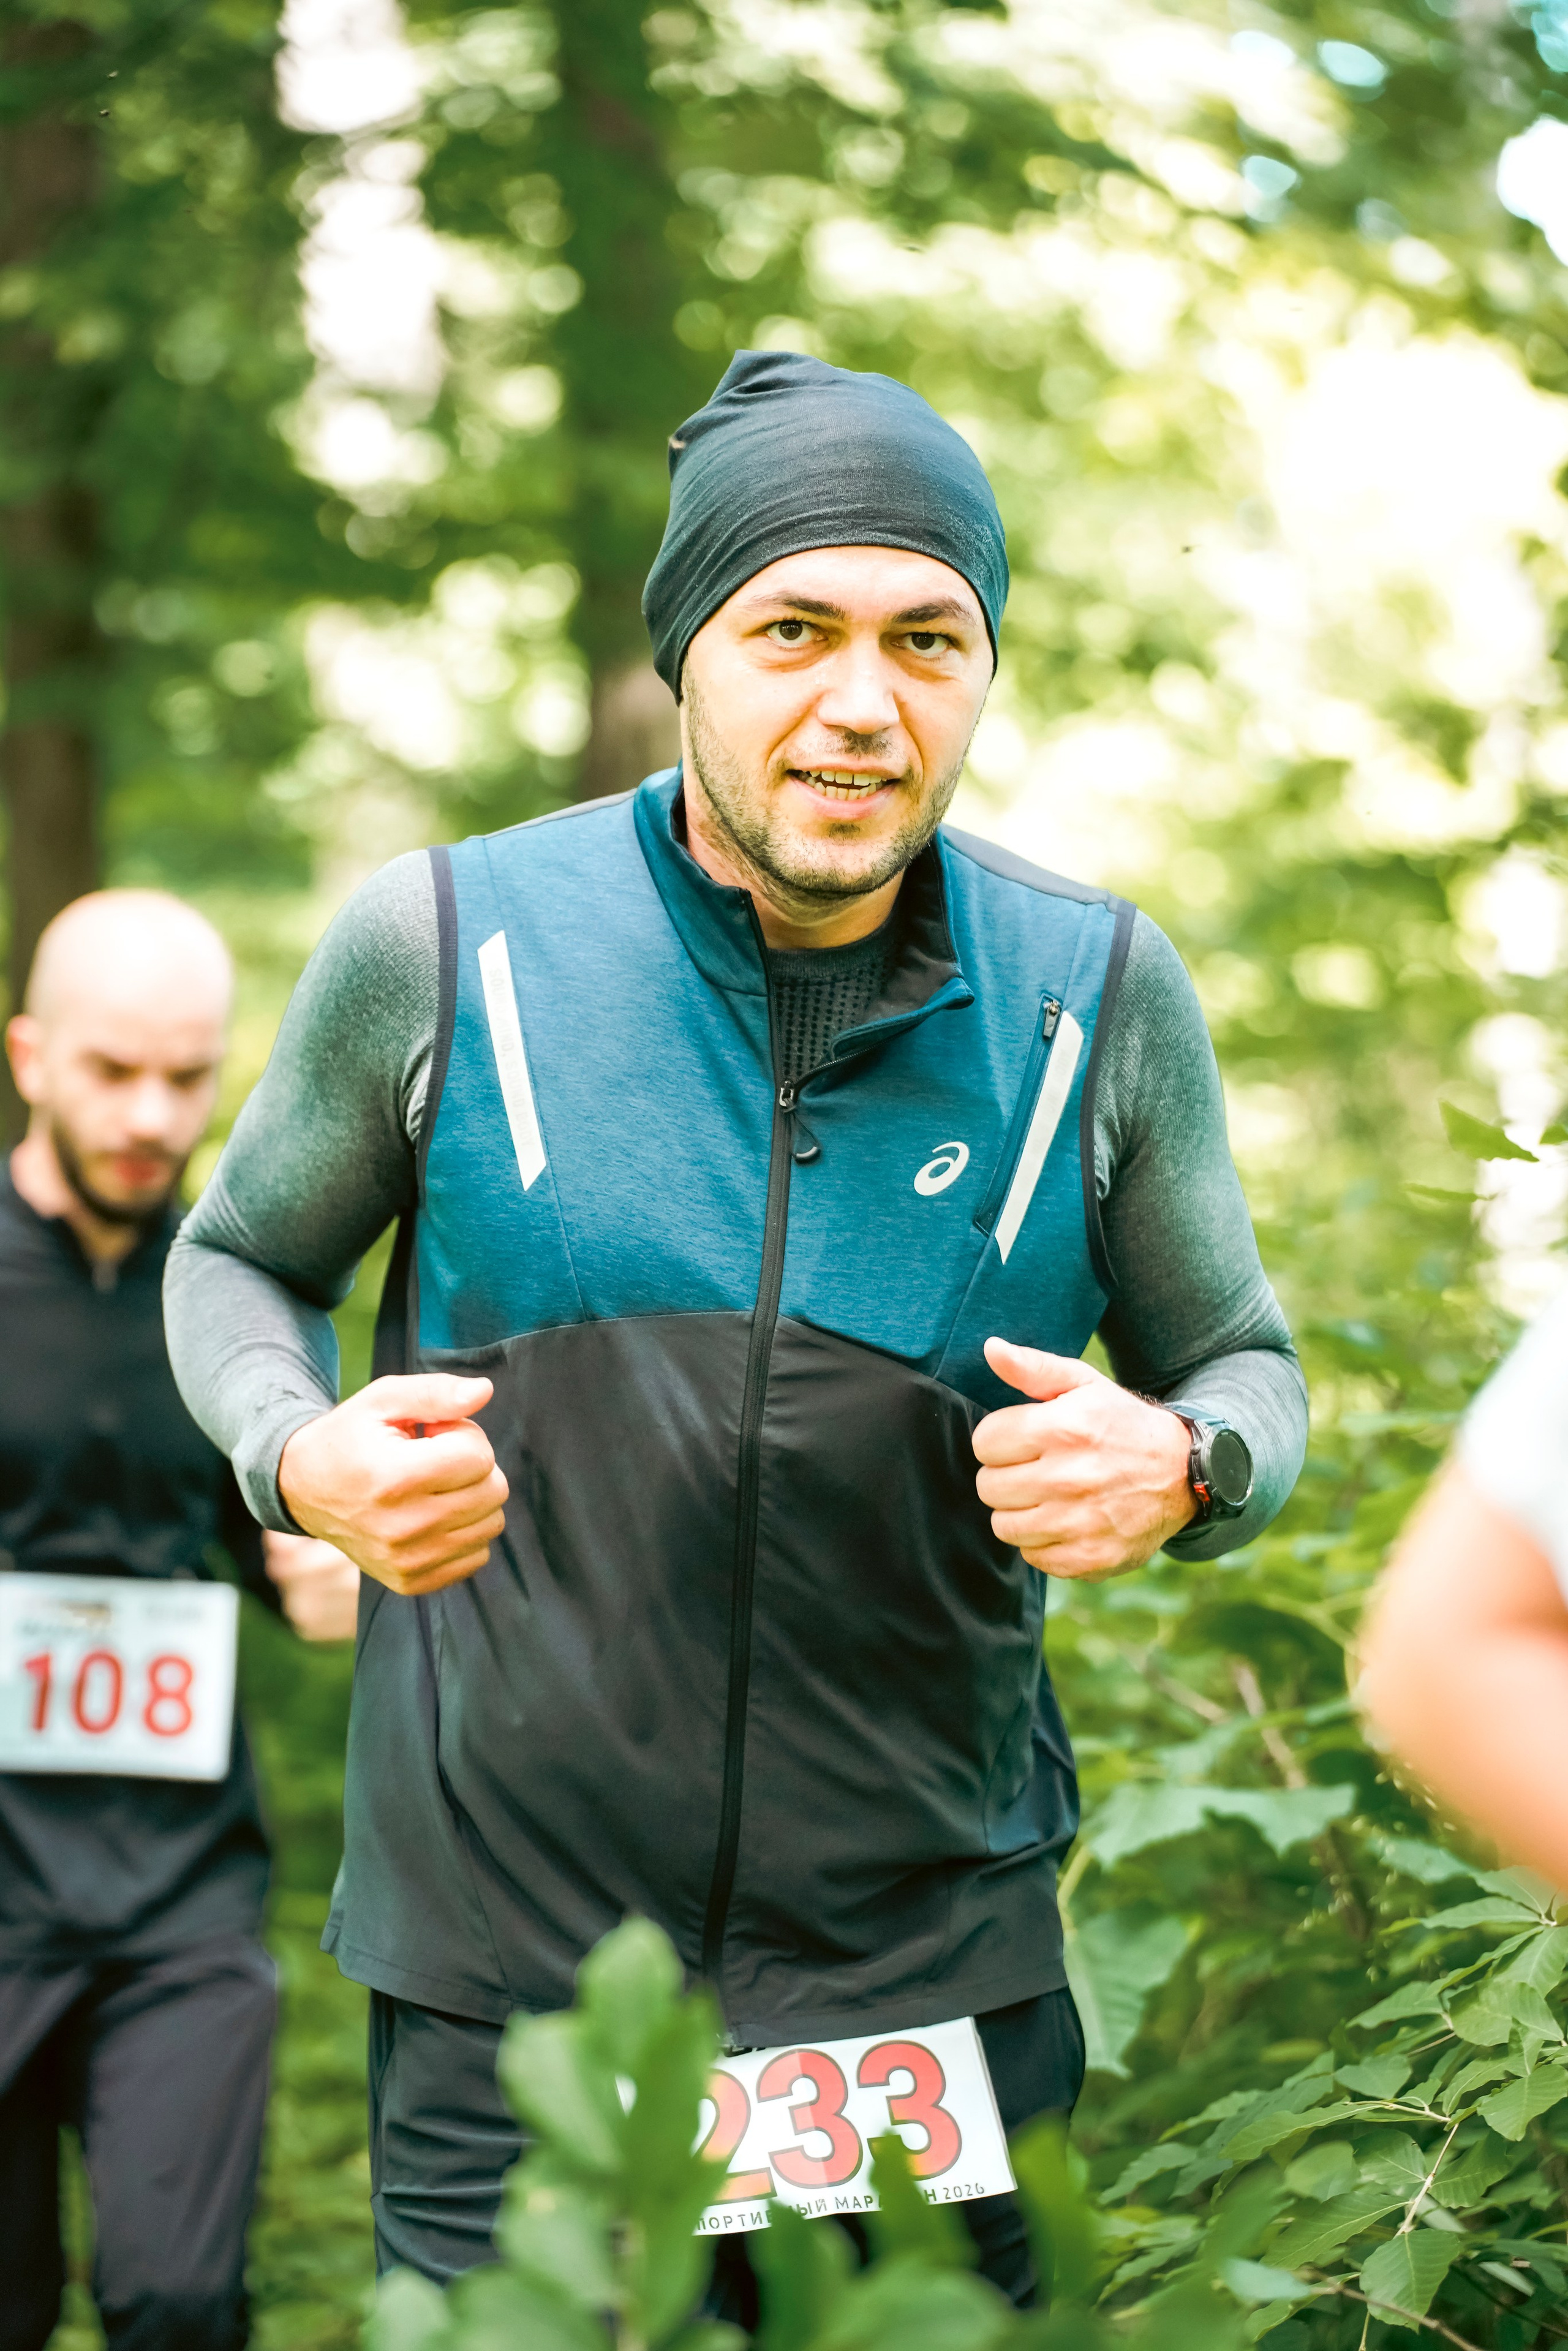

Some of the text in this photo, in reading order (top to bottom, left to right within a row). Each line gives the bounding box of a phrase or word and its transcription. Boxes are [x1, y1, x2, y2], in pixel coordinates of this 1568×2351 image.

[24, 1649, 194, 1738] 108
[691, 2039, 962, 2207] 233
[834, 2188, 937, 2209] МАРН
[943, 2182, 985, 2200] 2026
